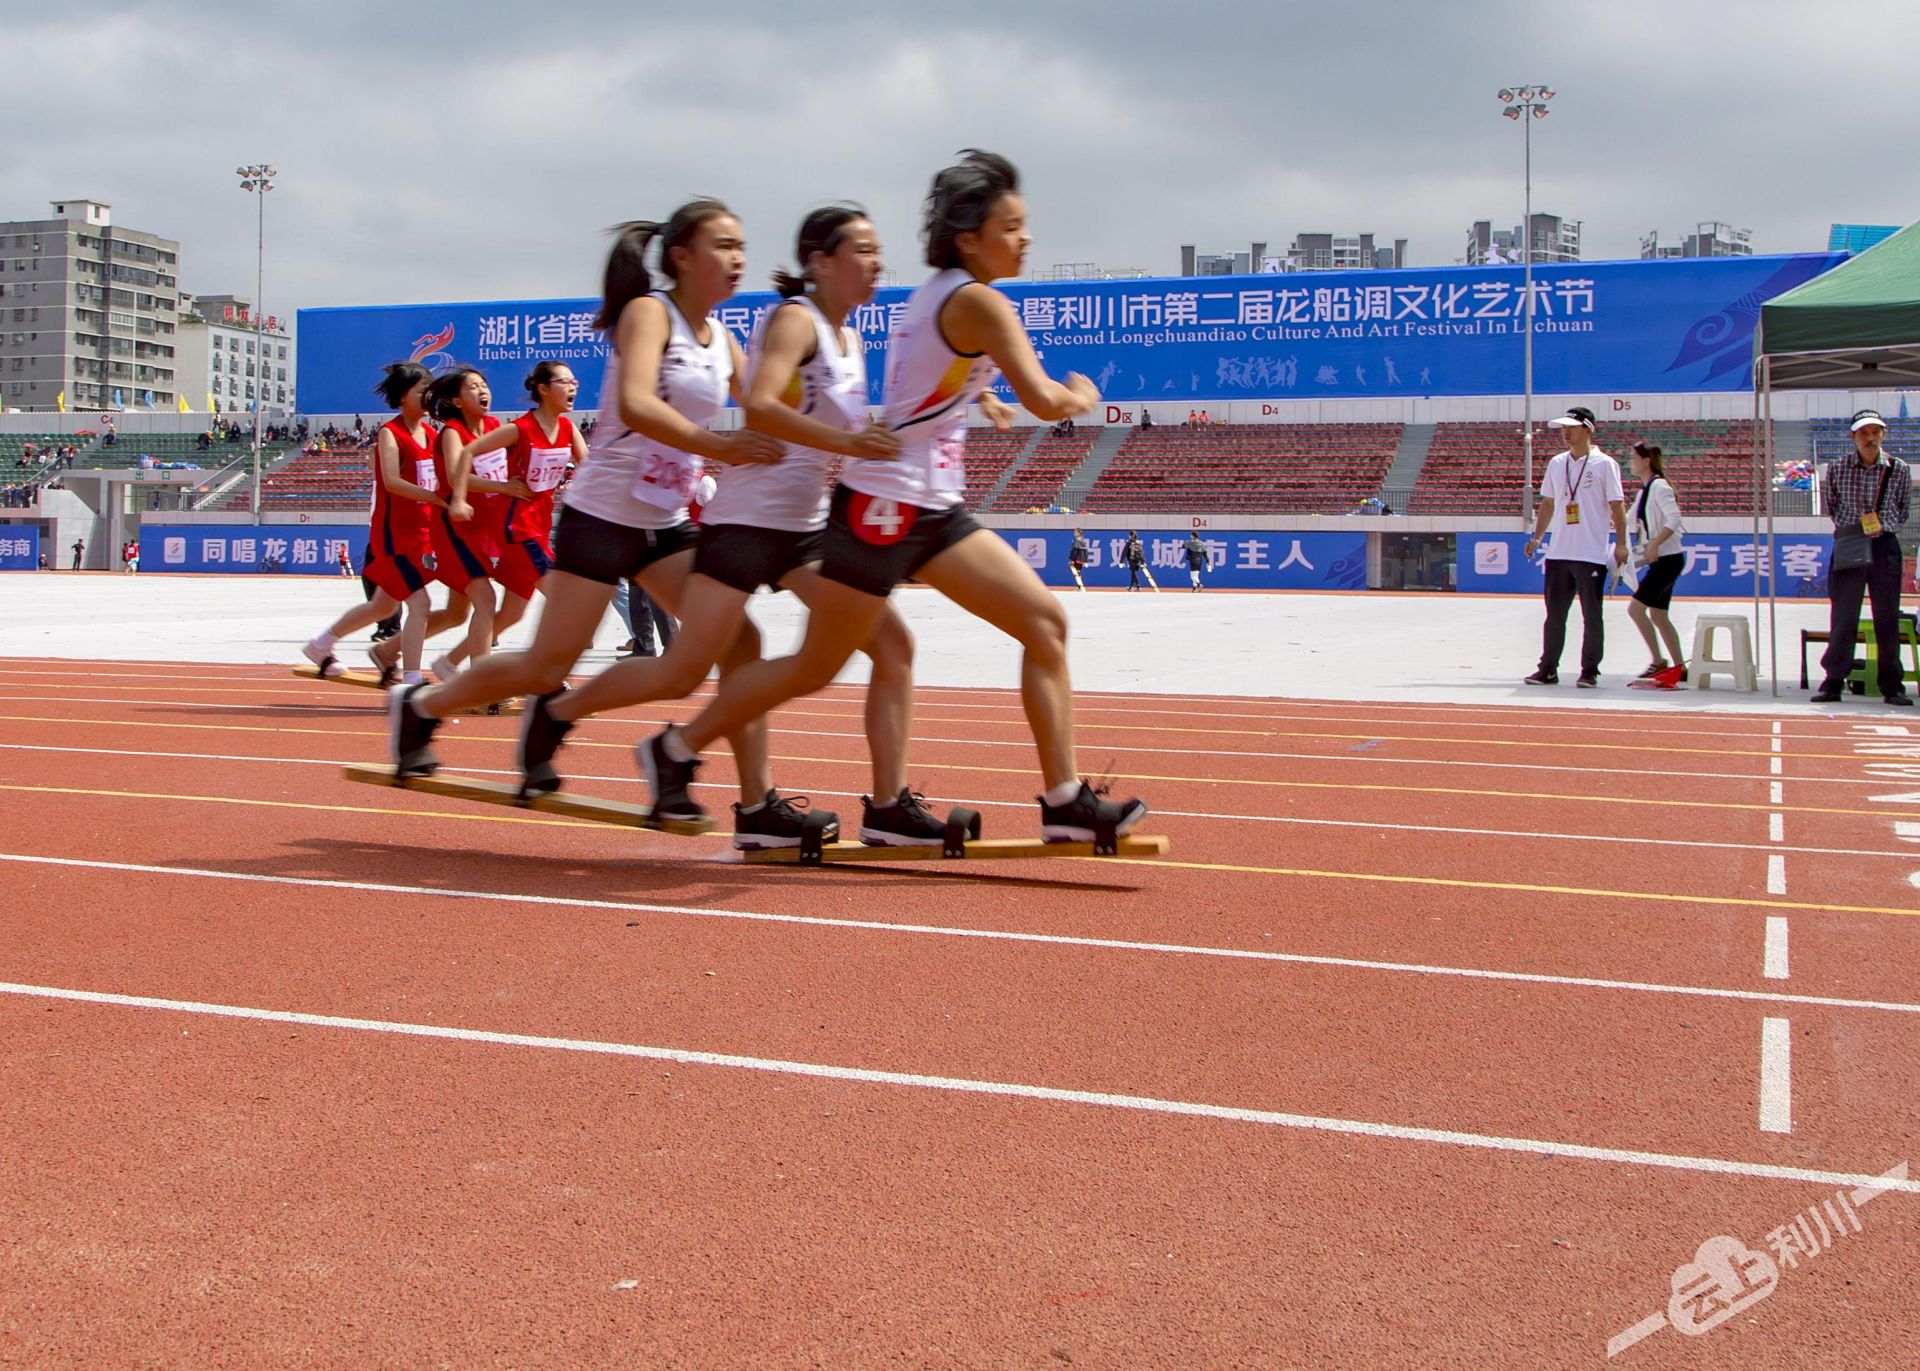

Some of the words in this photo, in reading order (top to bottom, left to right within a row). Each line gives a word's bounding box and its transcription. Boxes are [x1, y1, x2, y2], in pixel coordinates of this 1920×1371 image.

[479, 312, 604, 346] 湖北省第
[1010, 278, 1595, 331] 暨利川市第二届龙船调文化艺术节
[479, 346, 521, 360] Hubei
[525, 345, 589, 359] Province
[1042, 330, 1104, 345] Second
[1110, 326, 1247, 347] Longchuandiao
[1252, 326, 1321, 340] Culture
[1324, 323, 1363, 338] And
[1367, 322, 1399, 337] Art
[1404, 319, 1481, 336] Festival
[1488, 320, 1507, 334] In
[1262, 404, 1279, 416] D4
[1613, 399, 1632, 411] D5
[862, 496, 905, 536] 4
[1192, 517, 1208, 528] D4
[202, 537, 350, 565] 同唱龙船调
